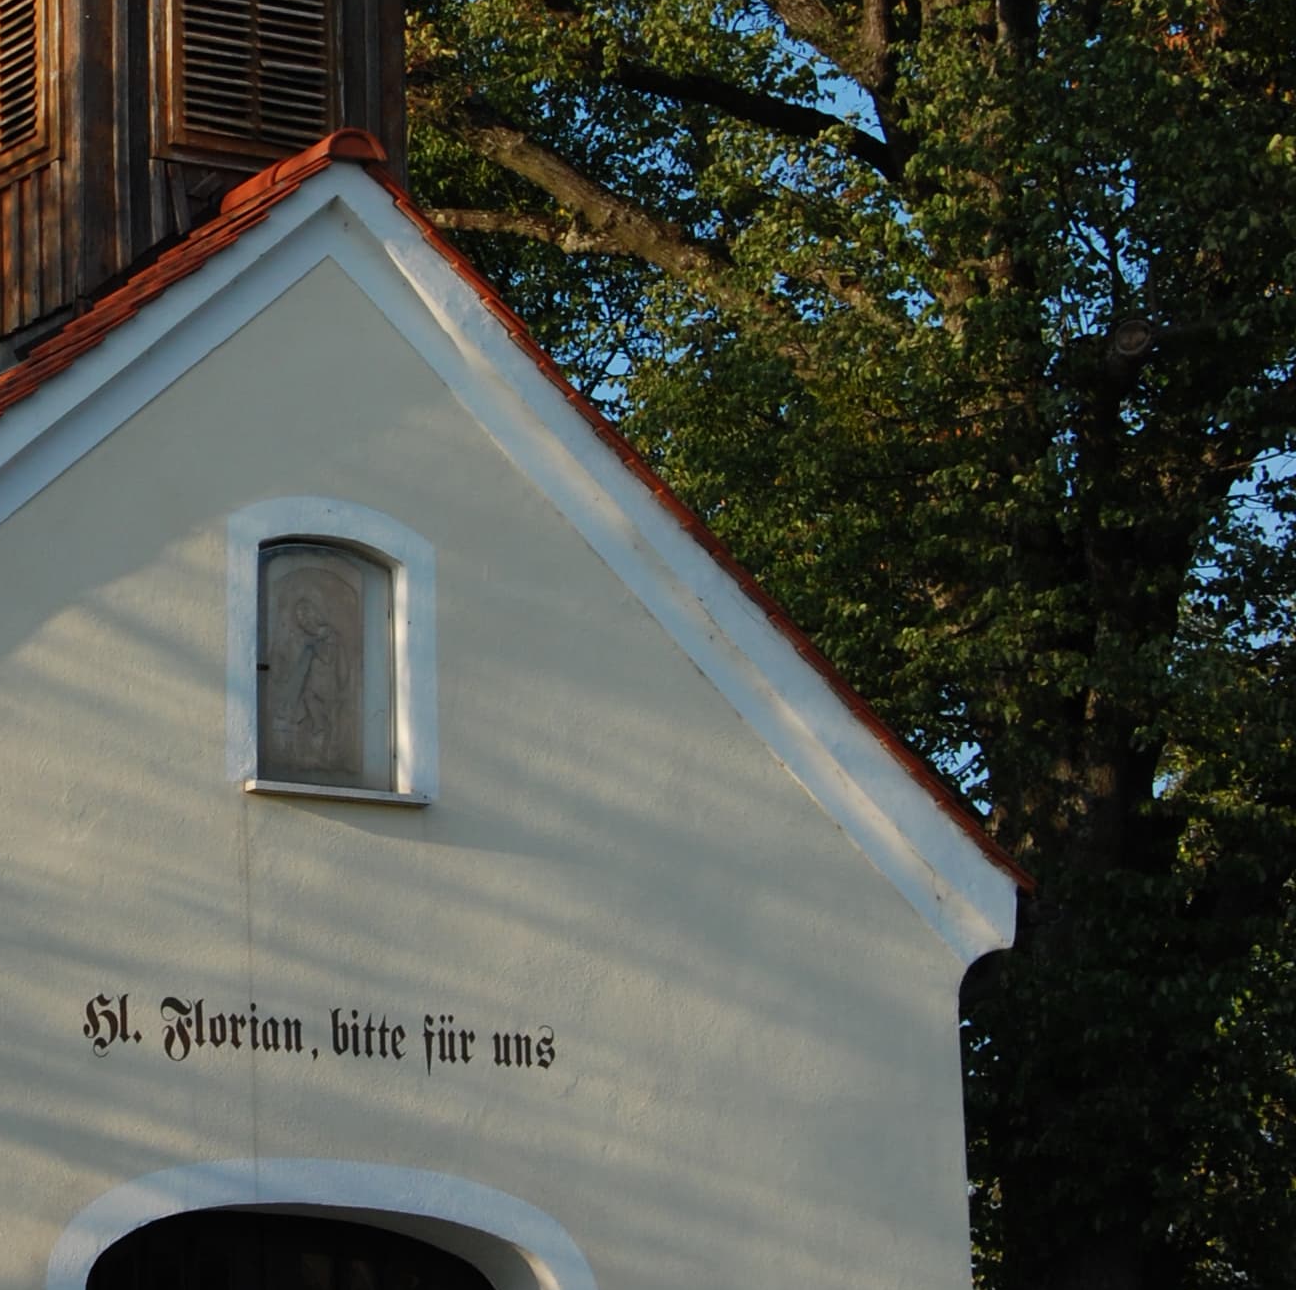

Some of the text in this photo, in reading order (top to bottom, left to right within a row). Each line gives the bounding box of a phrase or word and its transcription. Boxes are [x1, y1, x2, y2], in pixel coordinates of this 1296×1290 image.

[82, 992, 556, 1077] Hl. Florian, bitte für uns
